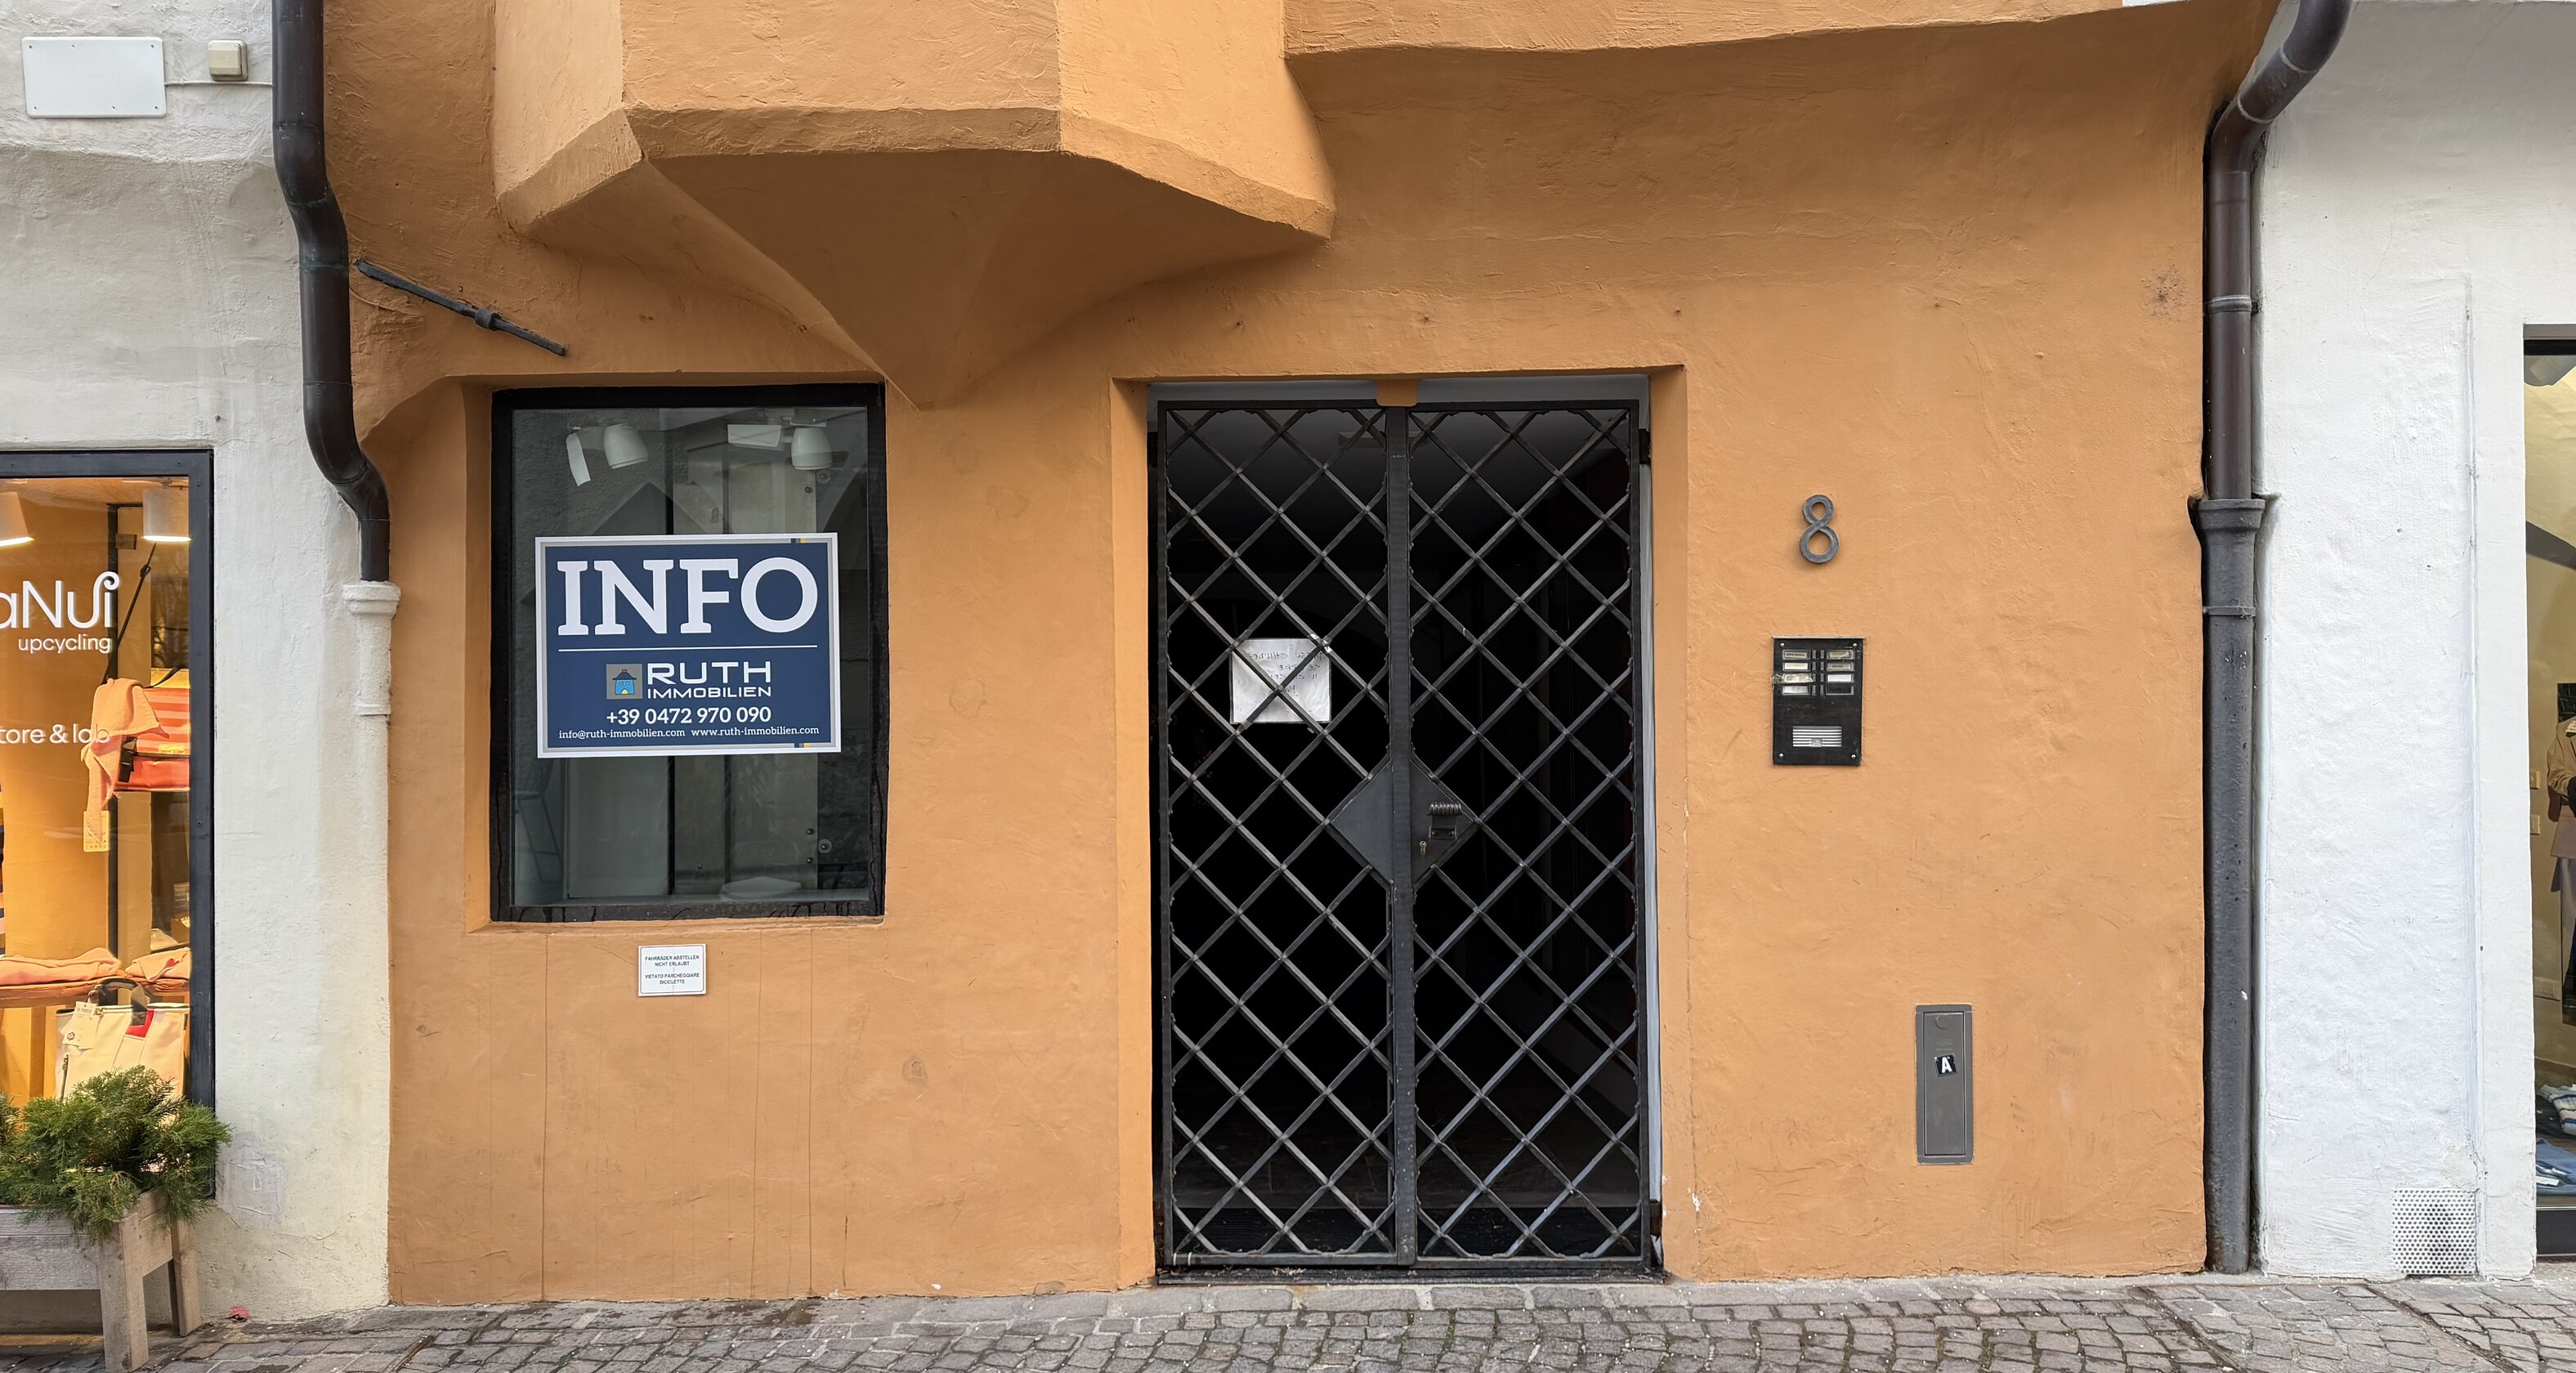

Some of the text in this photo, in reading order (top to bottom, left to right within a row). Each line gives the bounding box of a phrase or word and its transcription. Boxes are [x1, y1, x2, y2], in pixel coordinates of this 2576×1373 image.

[1800, 494, 1839, 564] 8
[557, 557, 818, 636] INFO
[18, 633, 112, 654] upcycling
[646, 661, 771, 685] RUTH
[646, 686, 771, 699] IMMOBILIEN
[606, 706, 771, 725] +39 0472 970 090
[49, 723, 68, 744] &
[73, 722, 110, 744] lab
[558, 726, 820, 740] info@ruth-immobilien.com www.ruth-immobilien.com
[1941, 1056, 1953, 1074] A
